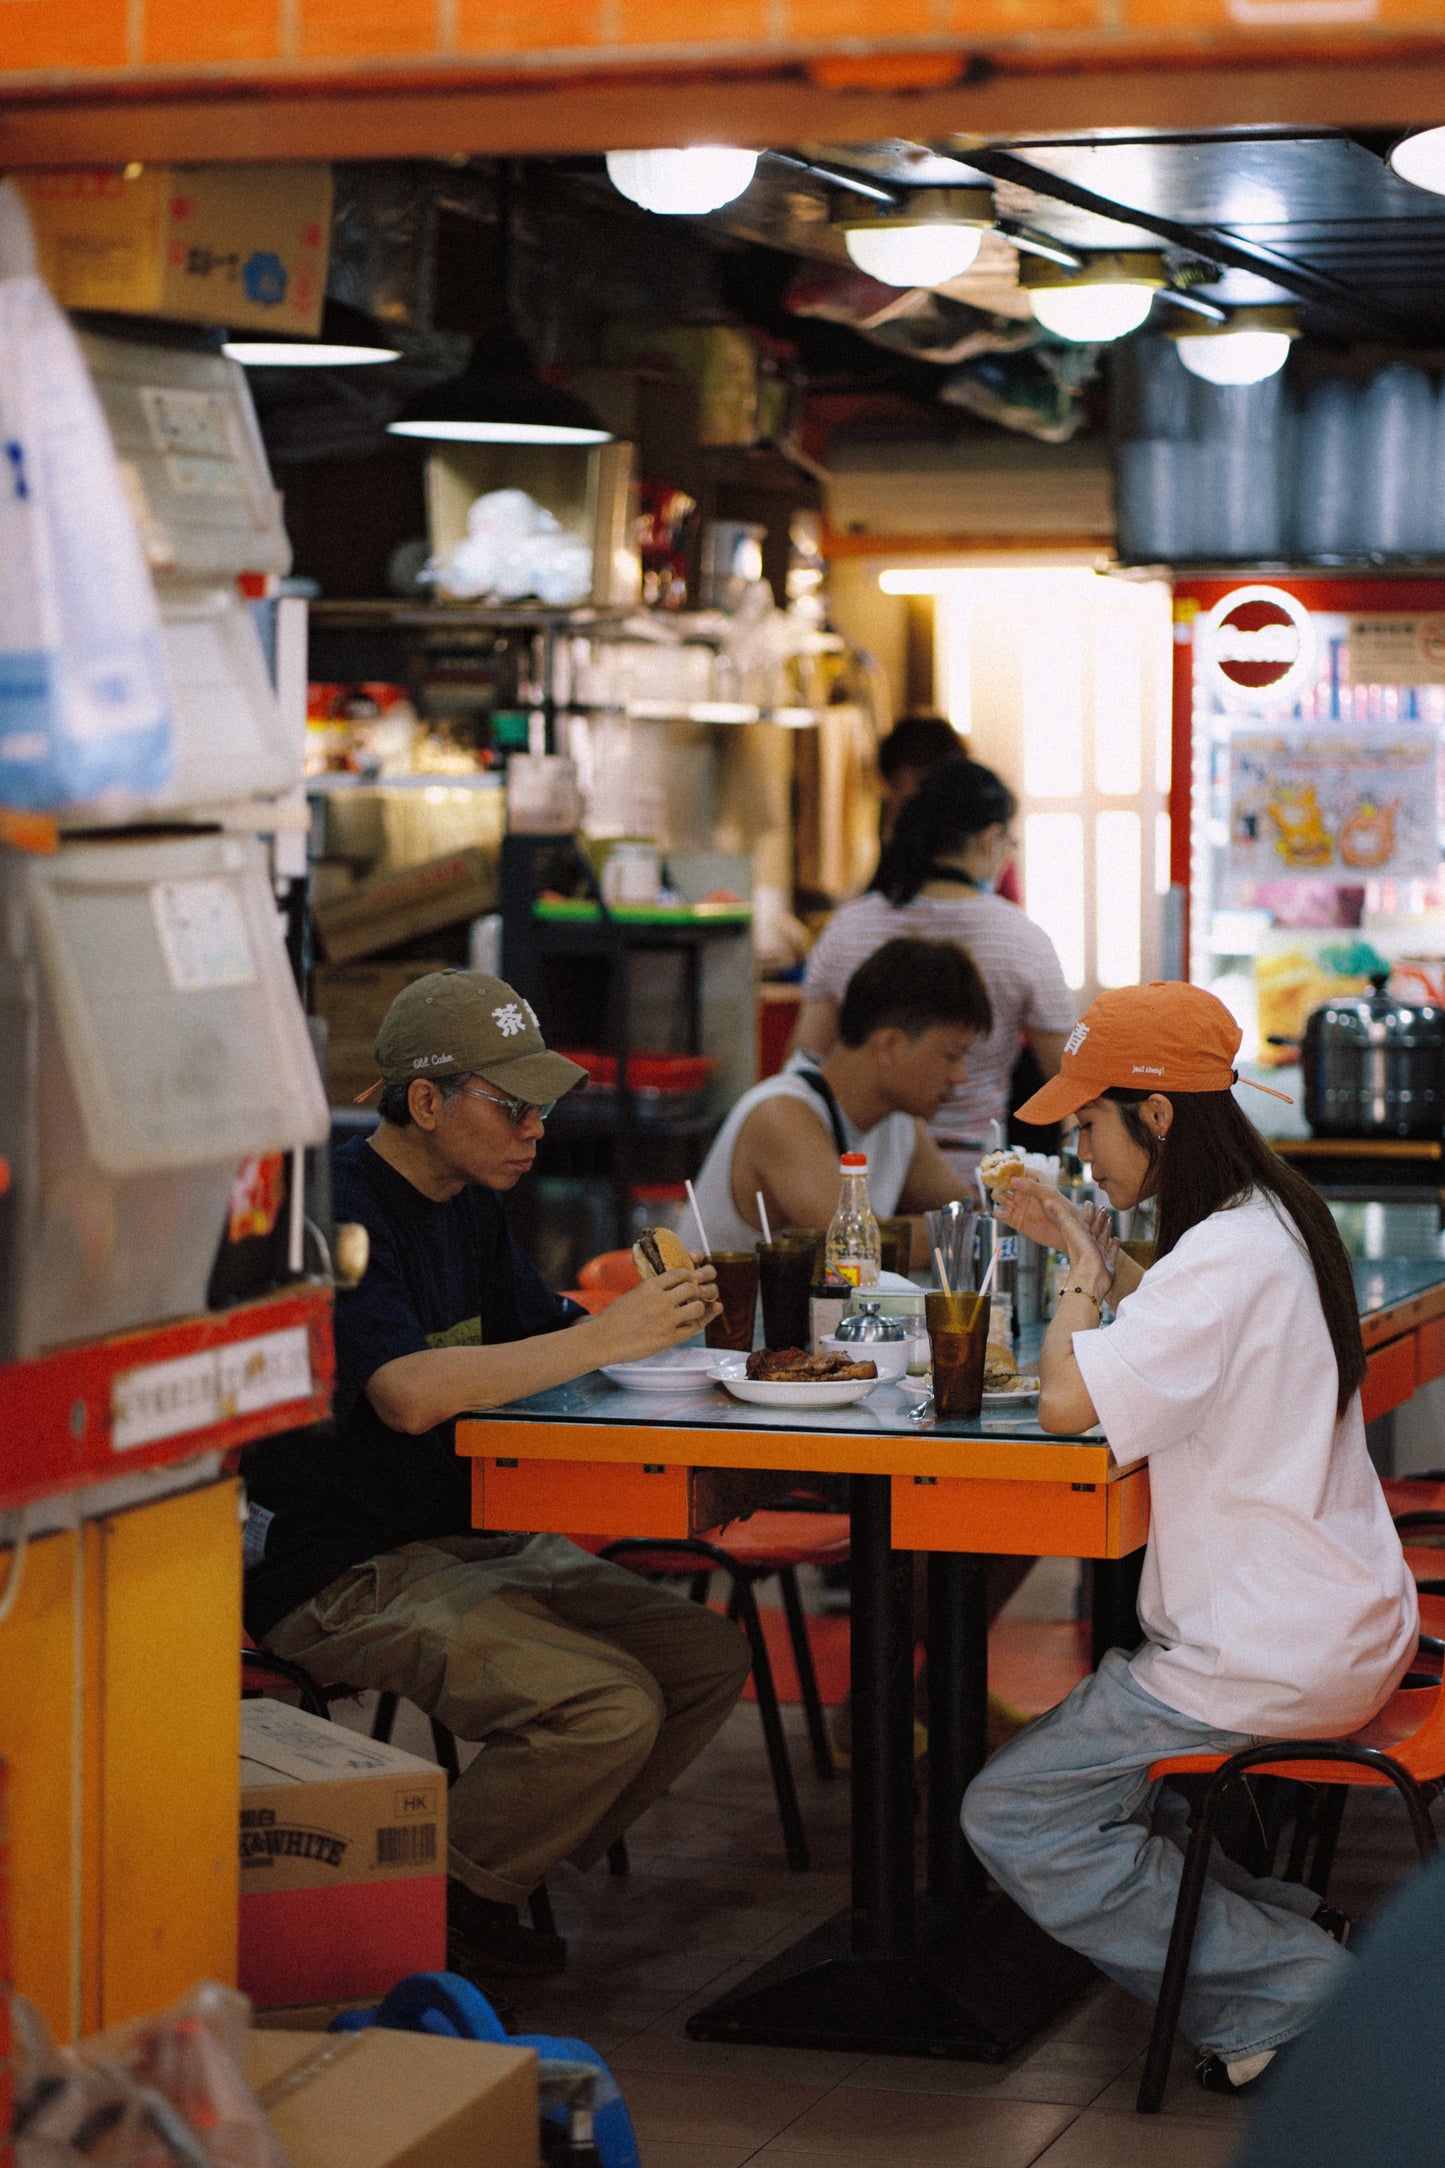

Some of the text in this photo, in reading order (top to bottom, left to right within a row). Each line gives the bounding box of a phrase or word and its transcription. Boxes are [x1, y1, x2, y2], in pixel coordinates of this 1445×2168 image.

[491, 999, 540, 1038] 茶
[413, 1056, 430, 1070] Old
[403, 1794, 428, 1811] HK
